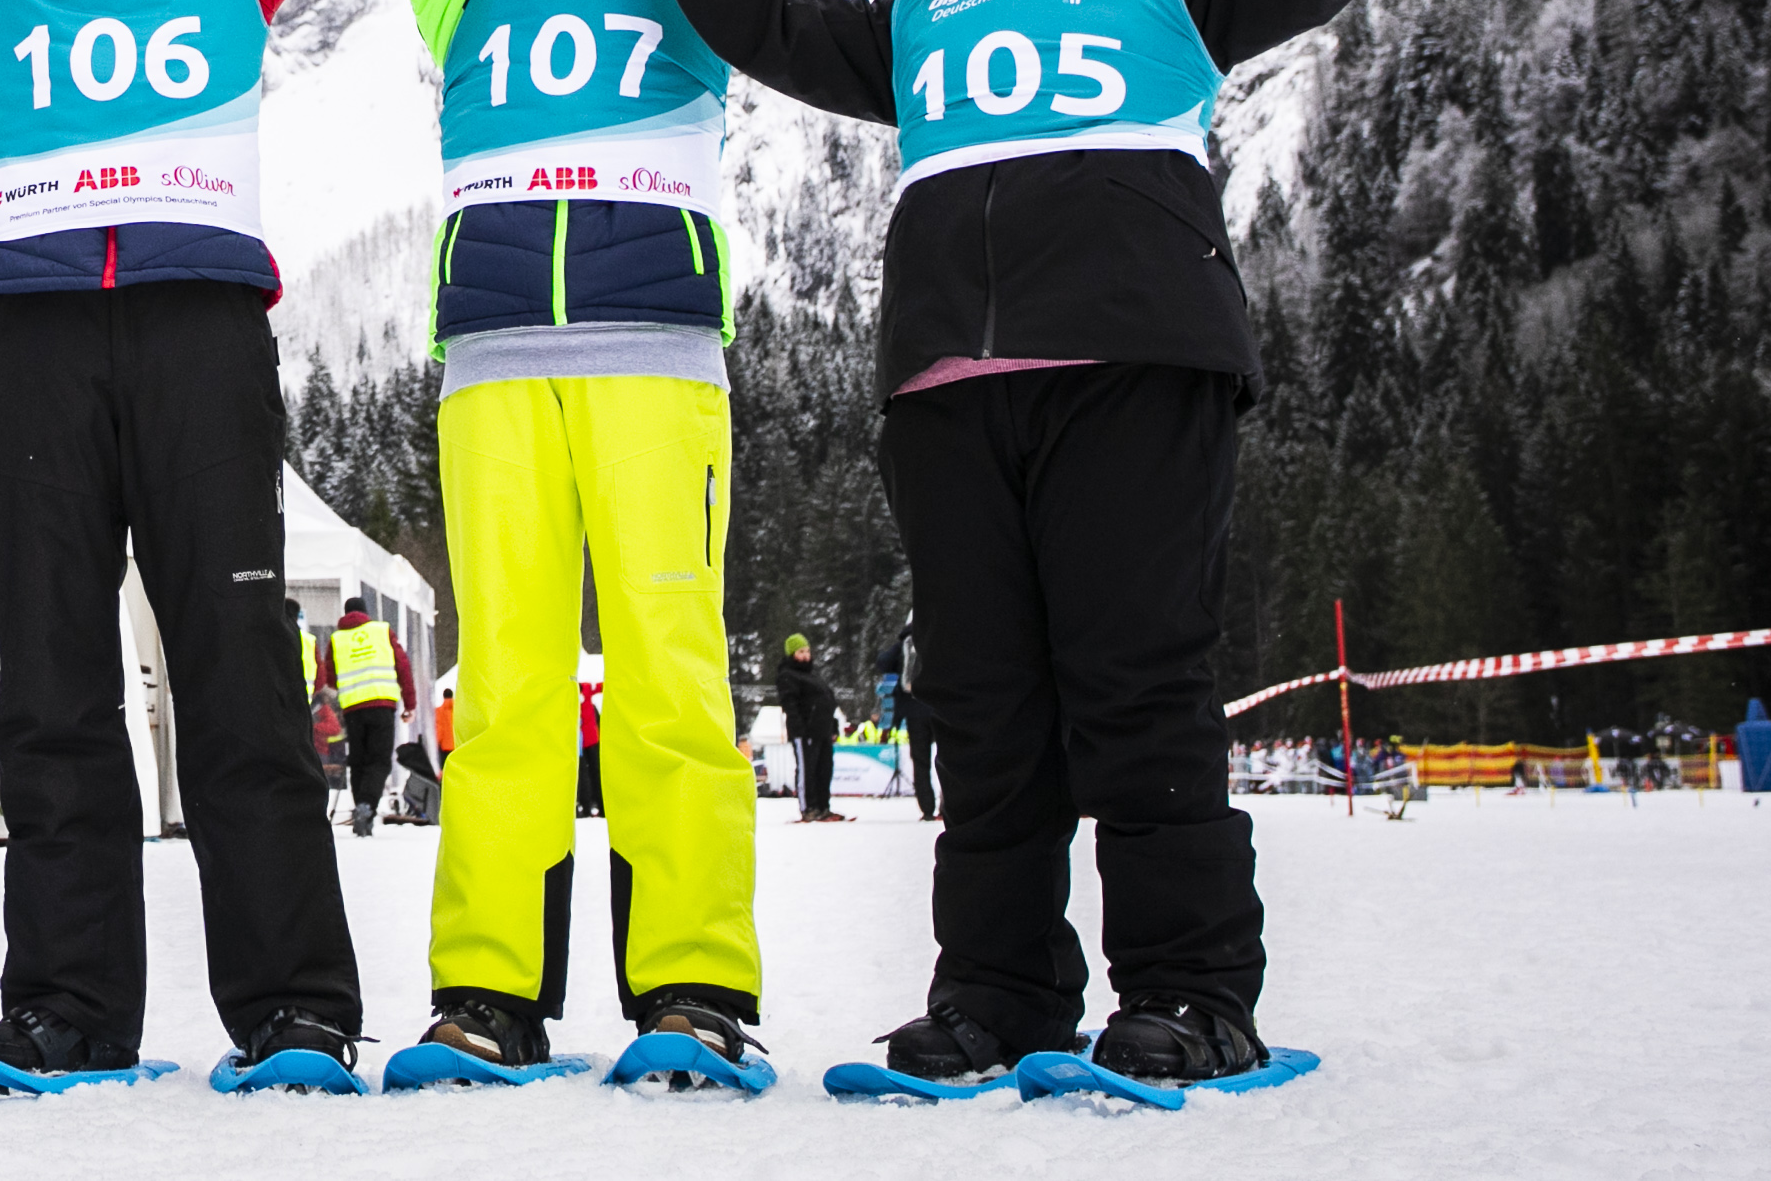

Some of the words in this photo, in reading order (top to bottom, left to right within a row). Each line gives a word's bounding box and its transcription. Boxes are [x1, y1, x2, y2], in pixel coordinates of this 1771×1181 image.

[14, 16, 210, 109] 106
[479, 14, 664, 107] 107
[912, 30, 1127, 121] 105
[5, 180, 59, 203] WÜRTH
[73, 166, 141, 194] ABB
[161, 165, 236, 197] s.Oliver
[9, 210, 40, 222] Premium
[42, 204, 71, 215] Partner
[73, 202, 87, 210] von
[89, 196, 121, 208] Special
[123, 196, 163, 205] Olympics
[165, 196, 218, 207] Deutschland
[526, 166, 599, 191] ABB
[618, 167, 694, 198] s.Oliver
